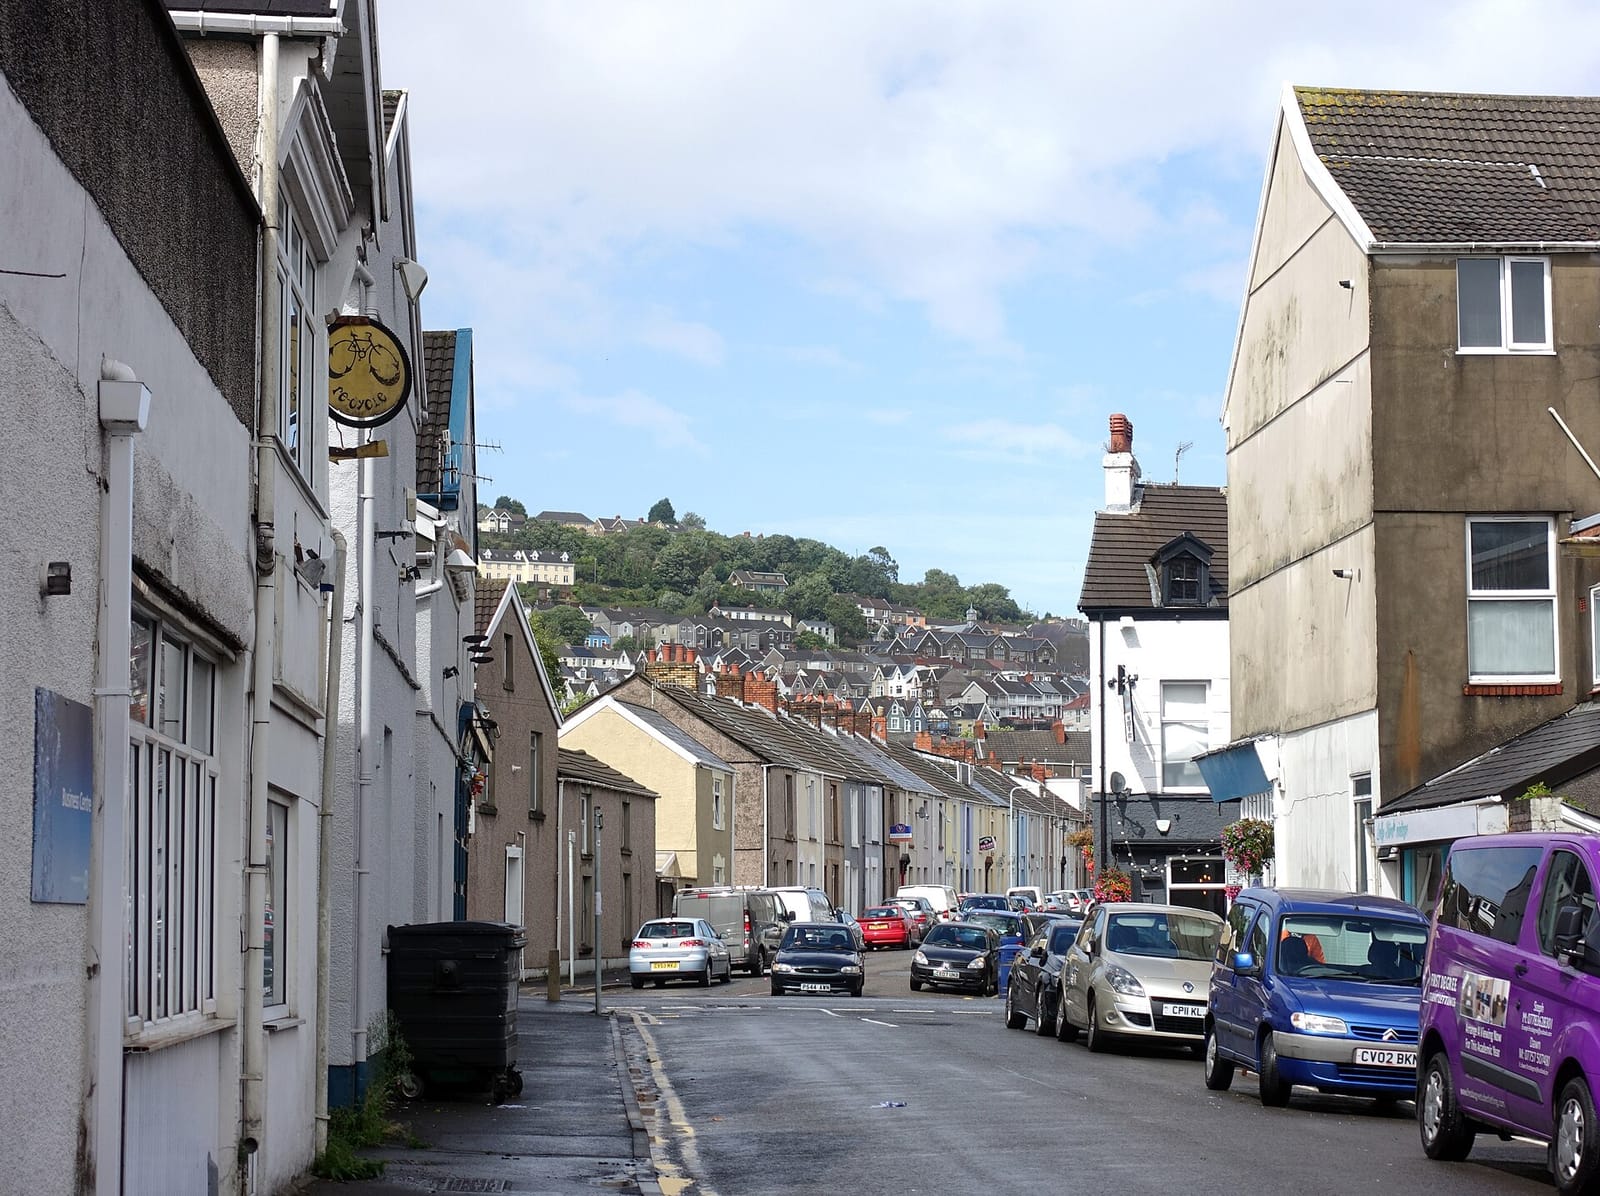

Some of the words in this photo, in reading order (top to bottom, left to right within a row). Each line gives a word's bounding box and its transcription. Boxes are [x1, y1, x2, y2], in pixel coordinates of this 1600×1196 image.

[332, 386, 387, 410] re-cycle
[62, 787, 80, 809] Business
[80, 791, 92, 813] Centre
[1440, 975, 1458, 992] DEGREE
[1172, 1005, 1189, 1016] CP11
[1190, 1007, 1206, 1017] KL
[1493, 1030, 1502, 1042] Now
[1361, 1050, 1394, 1064] CV02
